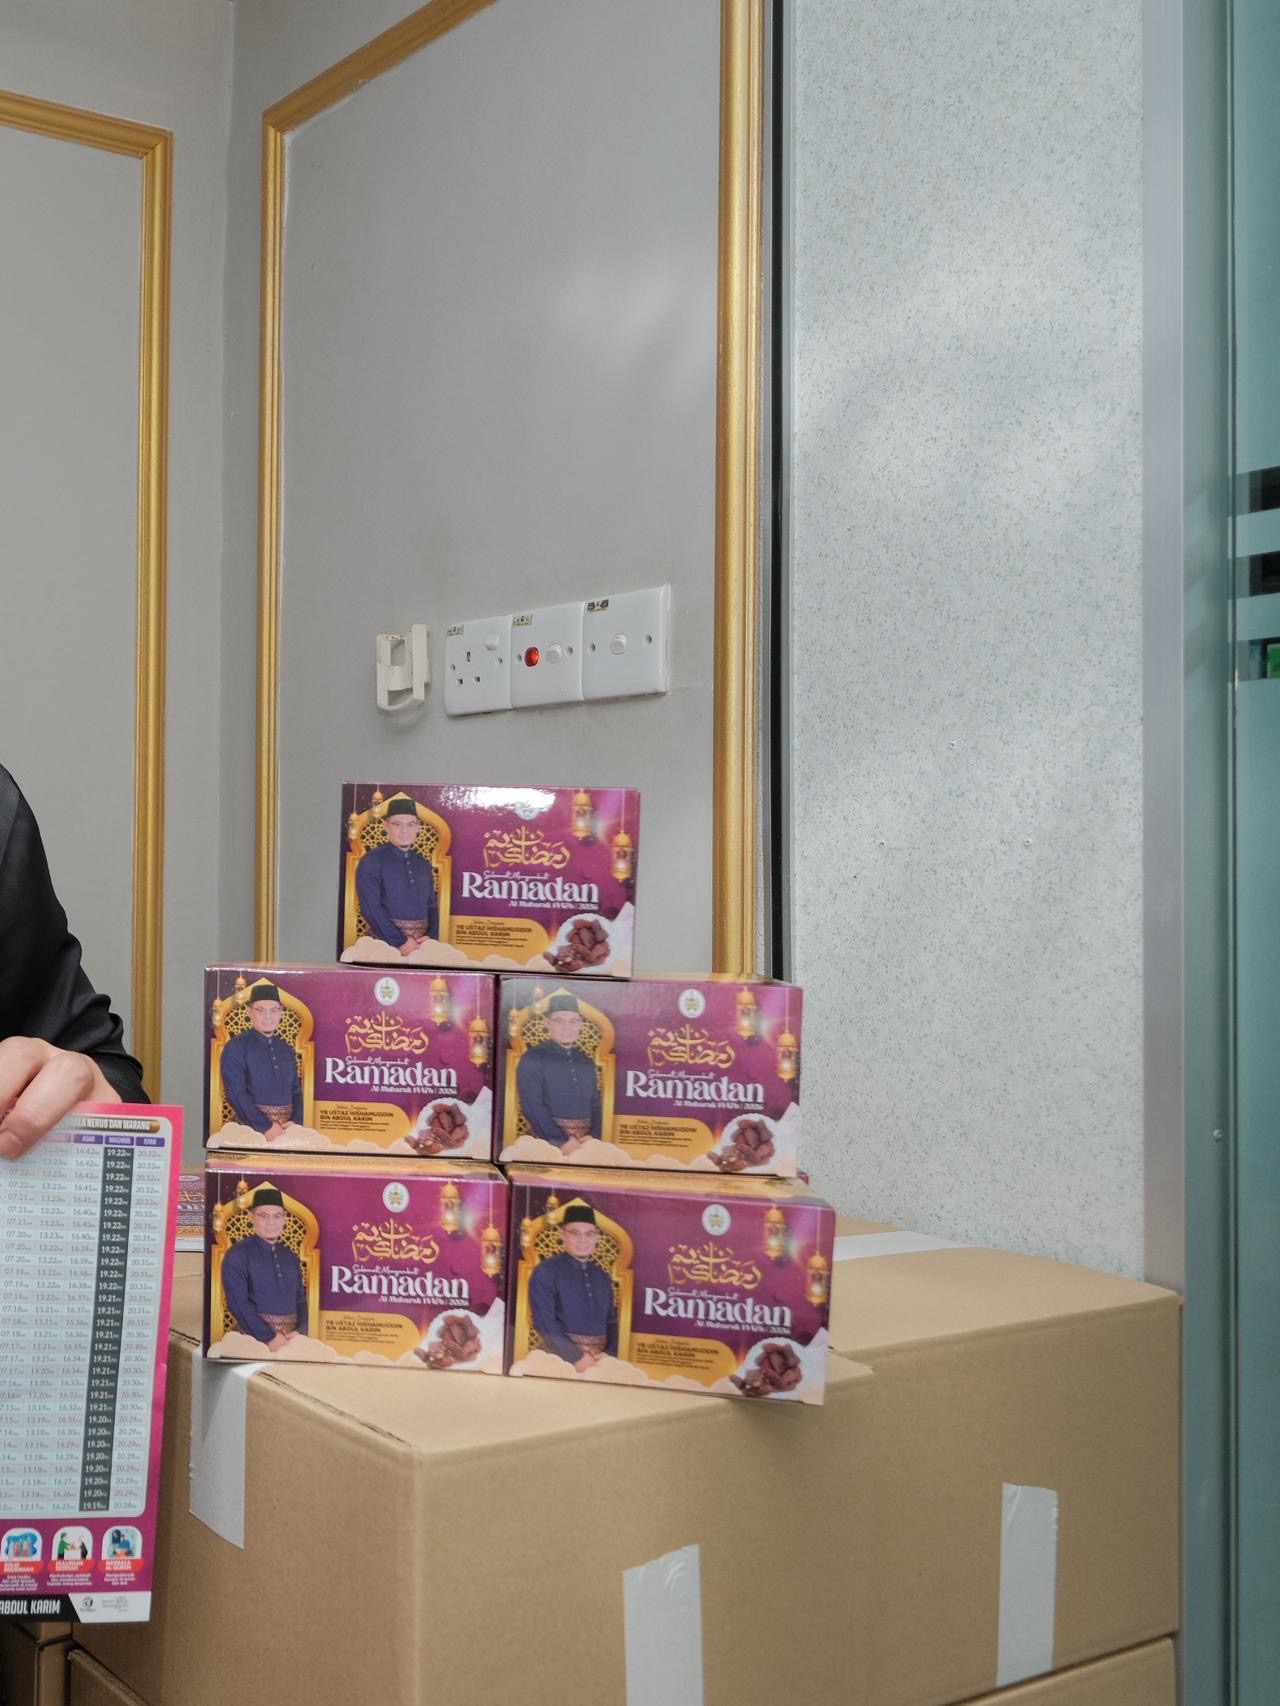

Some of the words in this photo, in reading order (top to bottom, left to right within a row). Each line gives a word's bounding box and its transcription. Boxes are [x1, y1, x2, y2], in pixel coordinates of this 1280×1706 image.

[461, 872, 599, 903] Ramadan
[325, 1057, 458, 1088] Ramadan
[625, 1070, 764, 1104] Ramadan
[87, 1120, 108, 1129] NERUS
[109, 1120, 122, 1129] DAN
[123, 1120, 151, 1130] MARANG
[331, 1266, 469, 1298] Ramadan
[644, 1287, 792, 1328] Ramadan
[30, 1600, 60, 1614] KARIM
